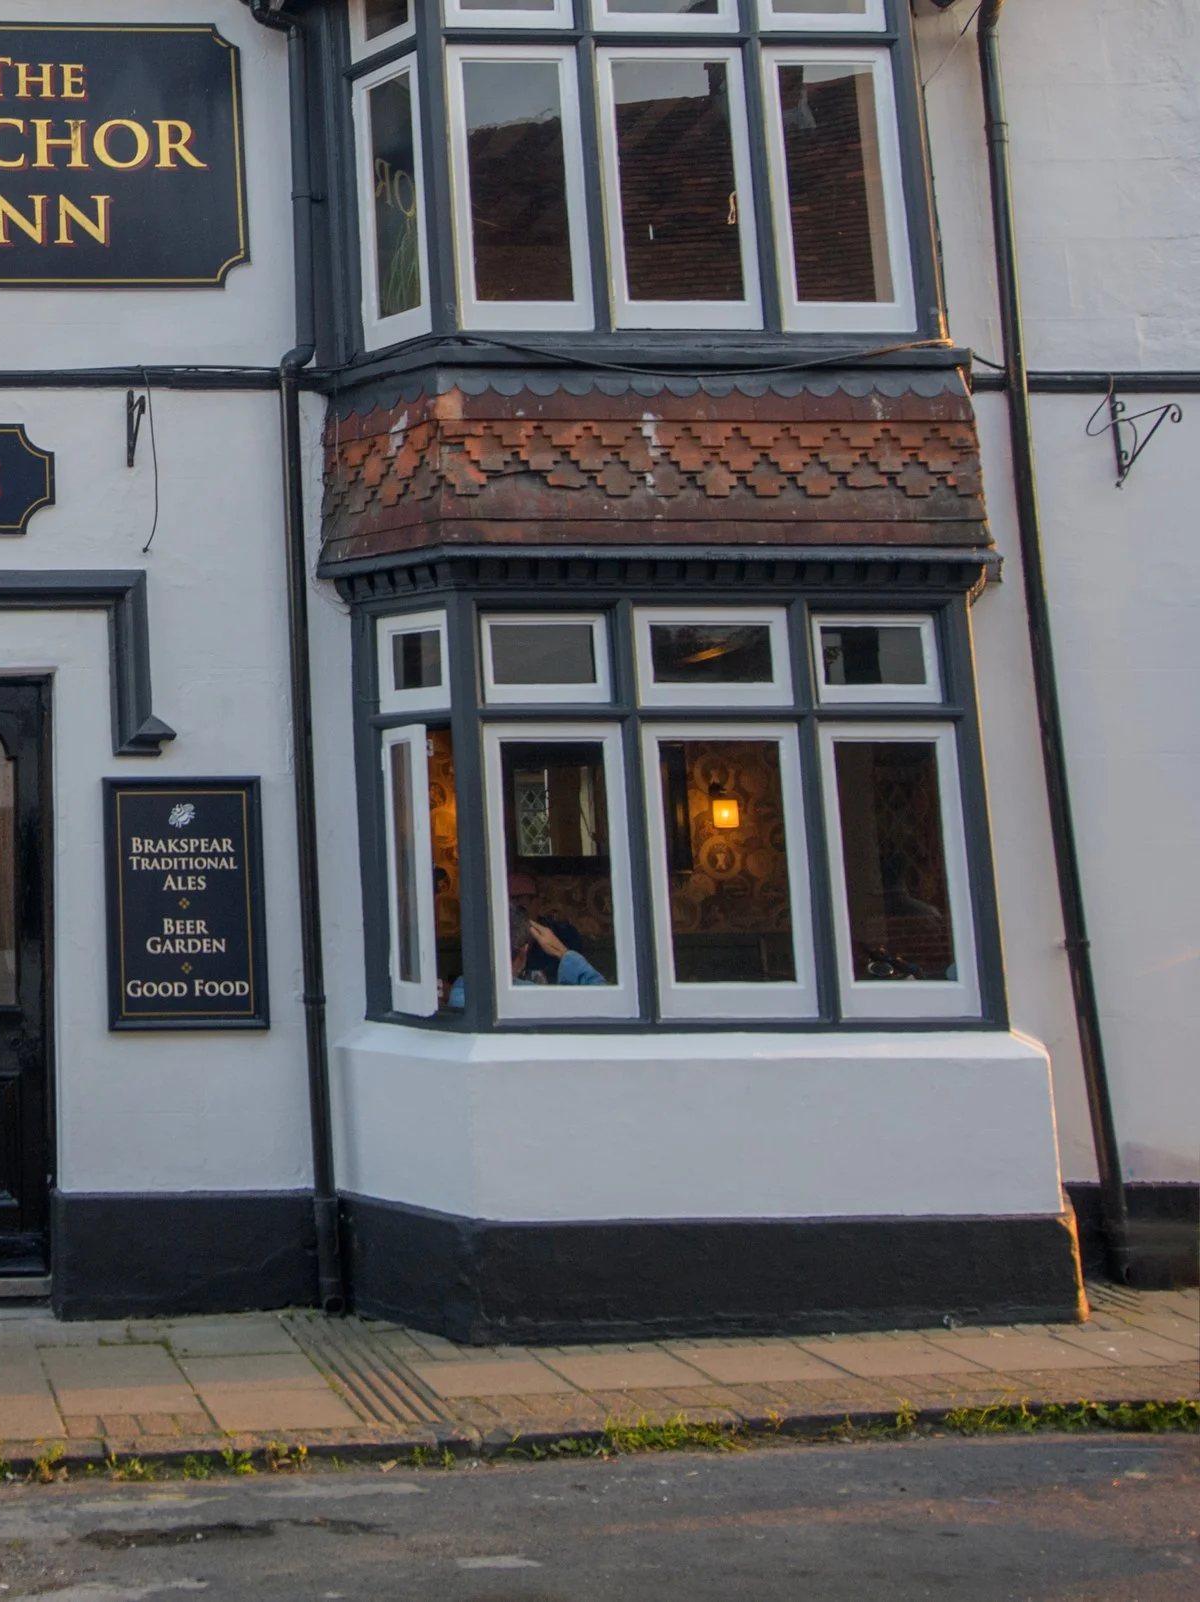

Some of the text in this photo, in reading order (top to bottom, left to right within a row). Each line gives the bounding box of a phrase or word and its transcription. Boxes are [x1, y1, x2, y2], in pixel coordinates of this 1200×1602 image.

[130, 836, 236, 854] BRAKSPEAR
[128, 855, 239, 871] TRADITIONAL
[161, 873, 208, 892] ALES
[162, 917, 210, 936] BEER
[145, 936, 227, 955] GARDEN
[125, 978, 251, 998] GOOD FOOD
